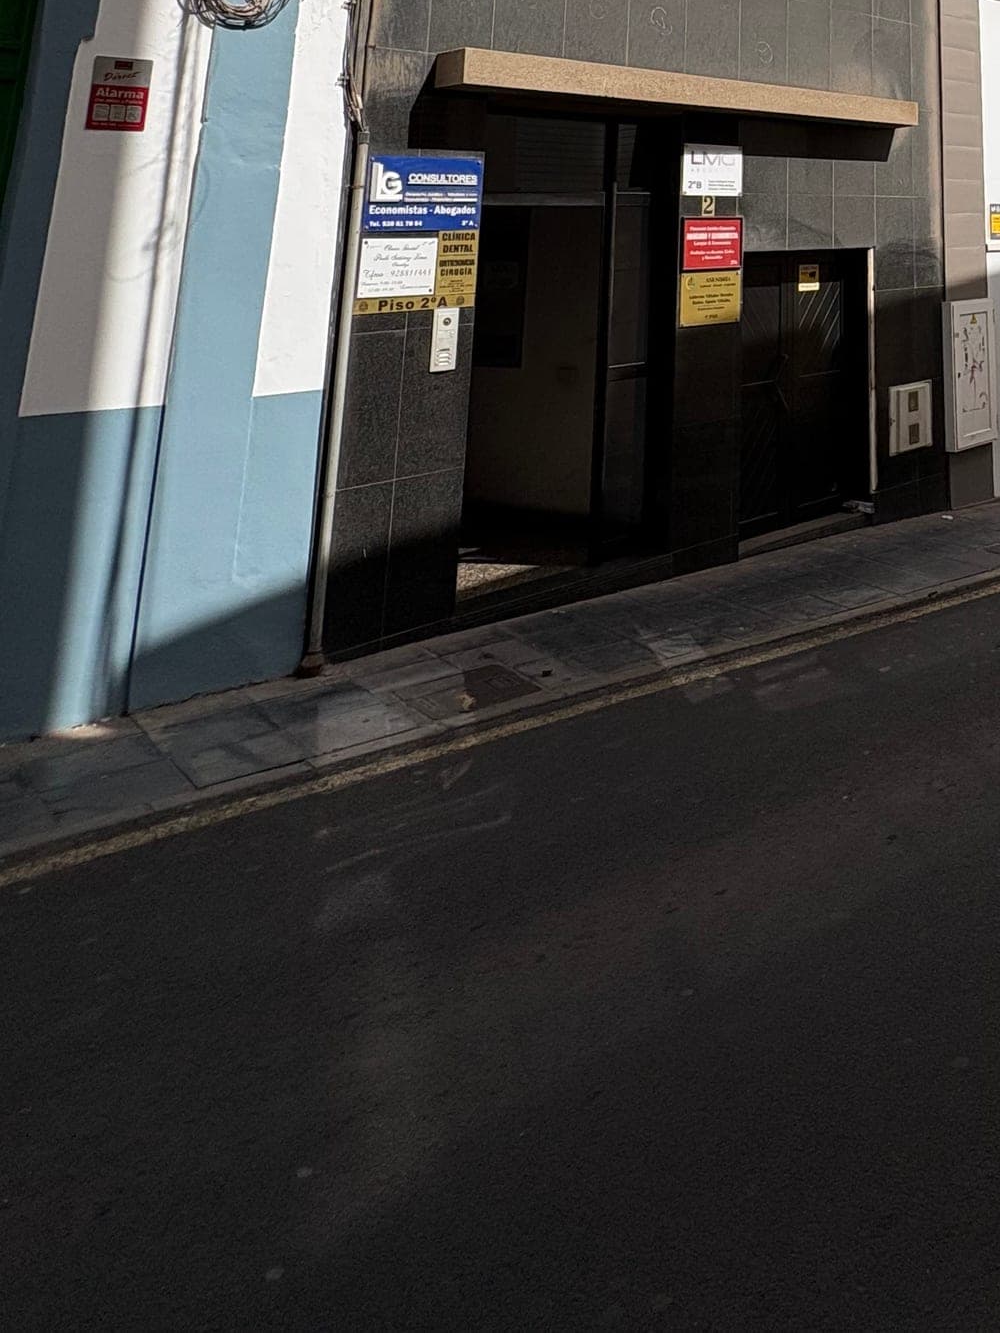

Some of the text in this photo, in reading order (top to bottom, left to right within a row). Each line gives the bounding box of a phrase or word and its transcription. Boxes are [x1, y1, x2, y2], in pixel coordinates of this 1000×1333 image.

[96, 87, 144, 100] Alarma
[408, 173, 478, 183] CONSULTORES
[369, 205, 428, 215] Economistas
[434, 205, 476, 216] Abogados
[703, 195, 714, 215] 2
[442, 232, 476, 241] CLÍNICA
[442, 244, 474, 253] DENTAL
[378, 299, 414, 312] Piso
